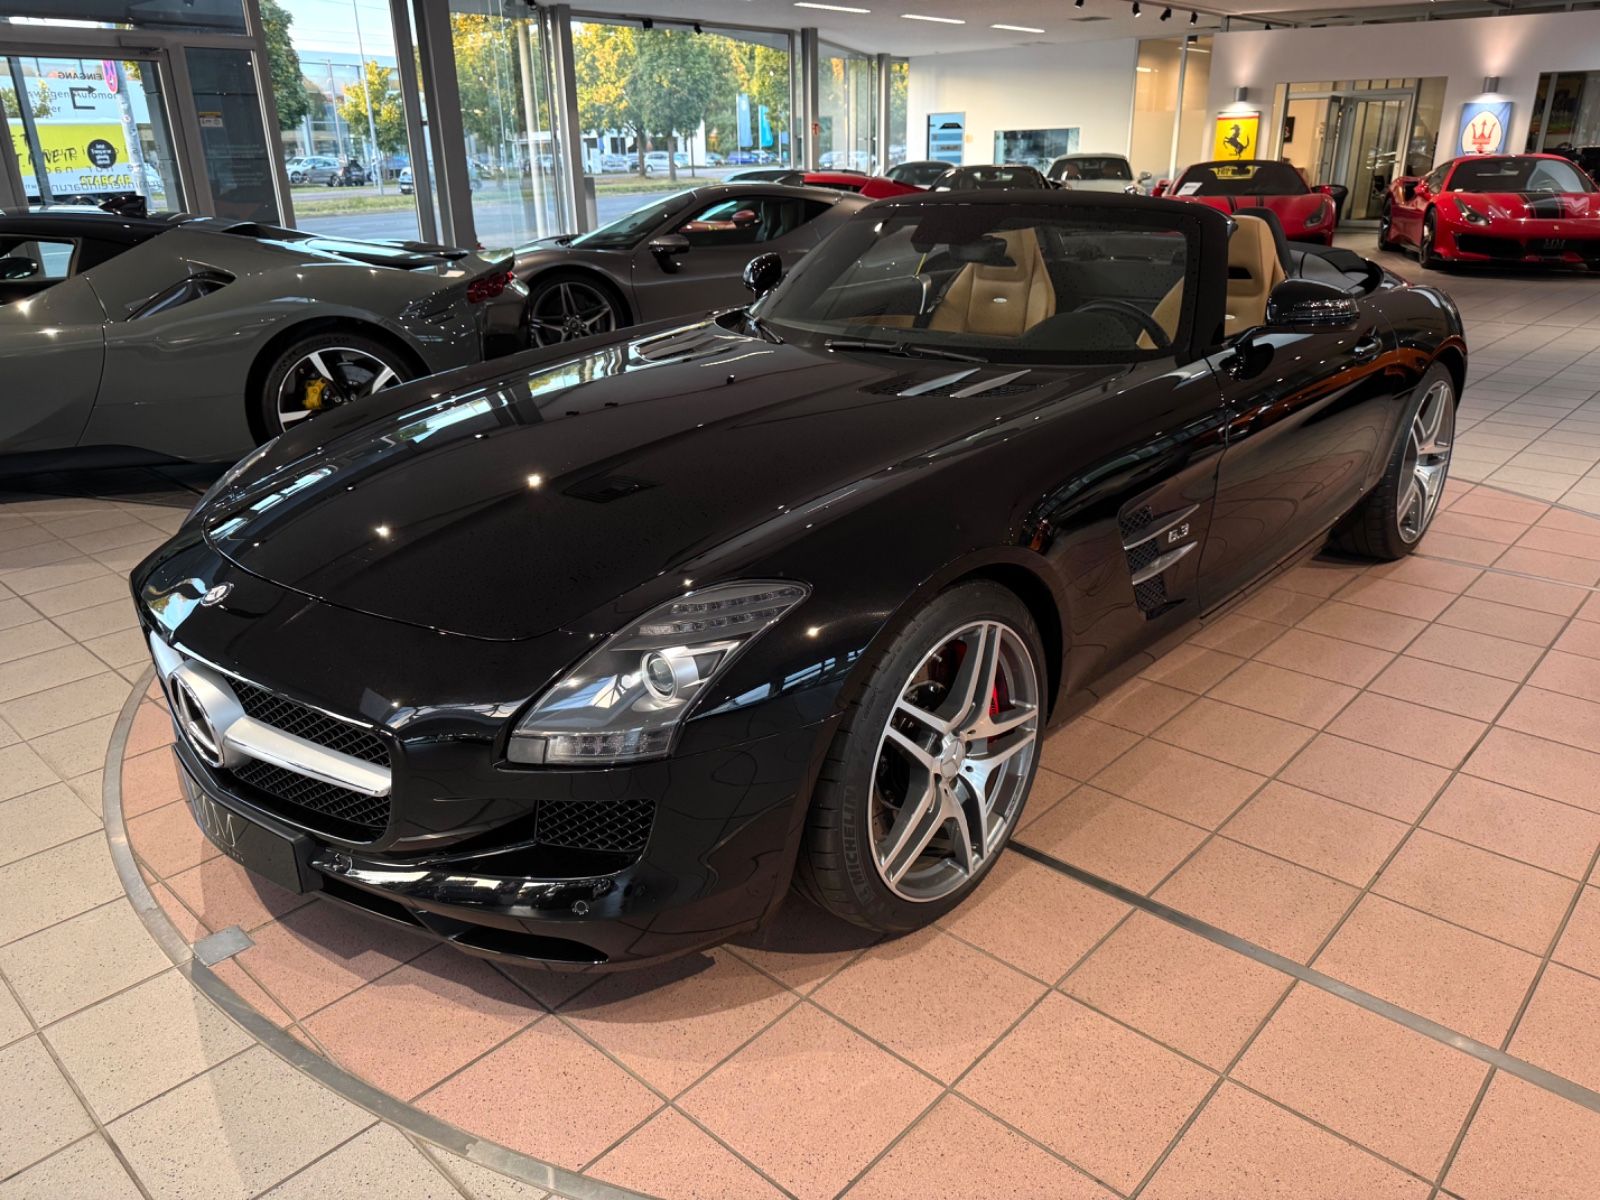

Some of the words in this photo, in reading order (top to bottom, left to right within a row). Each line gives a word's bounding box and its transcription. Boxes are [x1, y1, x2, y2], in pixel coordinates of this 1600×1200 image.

[80, 174, 132, 186] STARCAR
[1168, 523, 1190, 543] 6.3
[843, 785, 867, 887] MICHELIN
